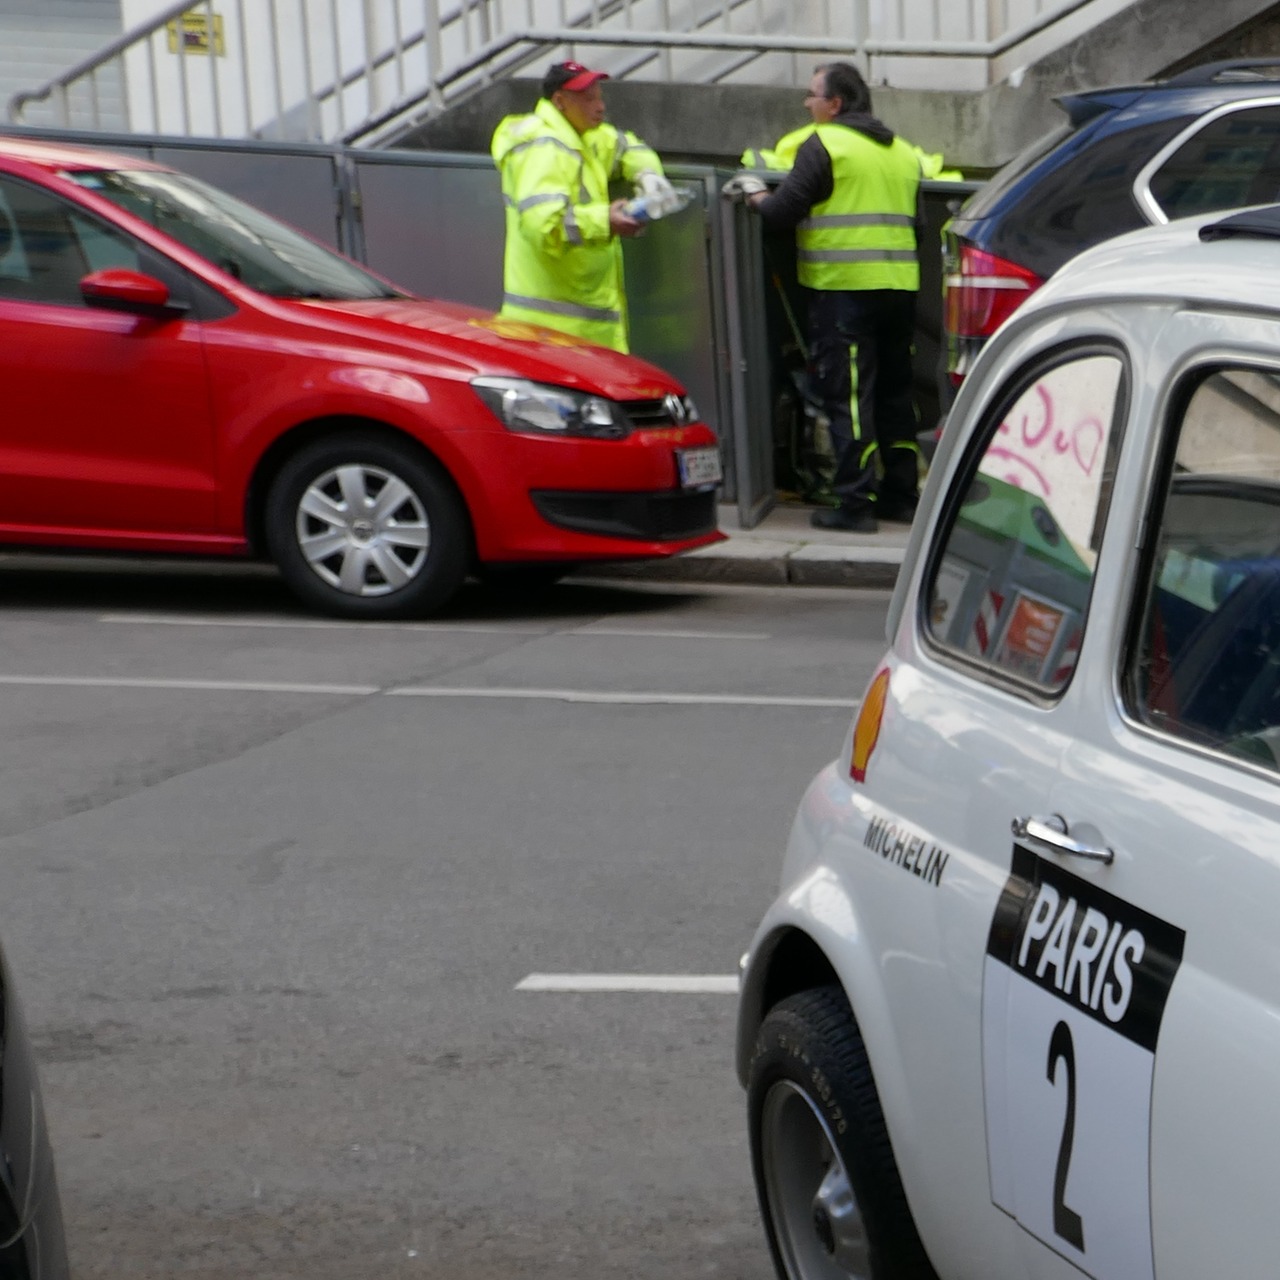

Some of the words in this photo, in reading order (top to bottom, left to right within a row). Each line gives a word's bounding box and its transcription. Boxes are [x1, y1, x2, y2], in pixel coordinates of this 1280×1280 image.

[863, 815, 950, 887] MICHELIN
[1017, 882, 1147, 1024] PARIS
[1046, 1019, 1085, 1254] 2
